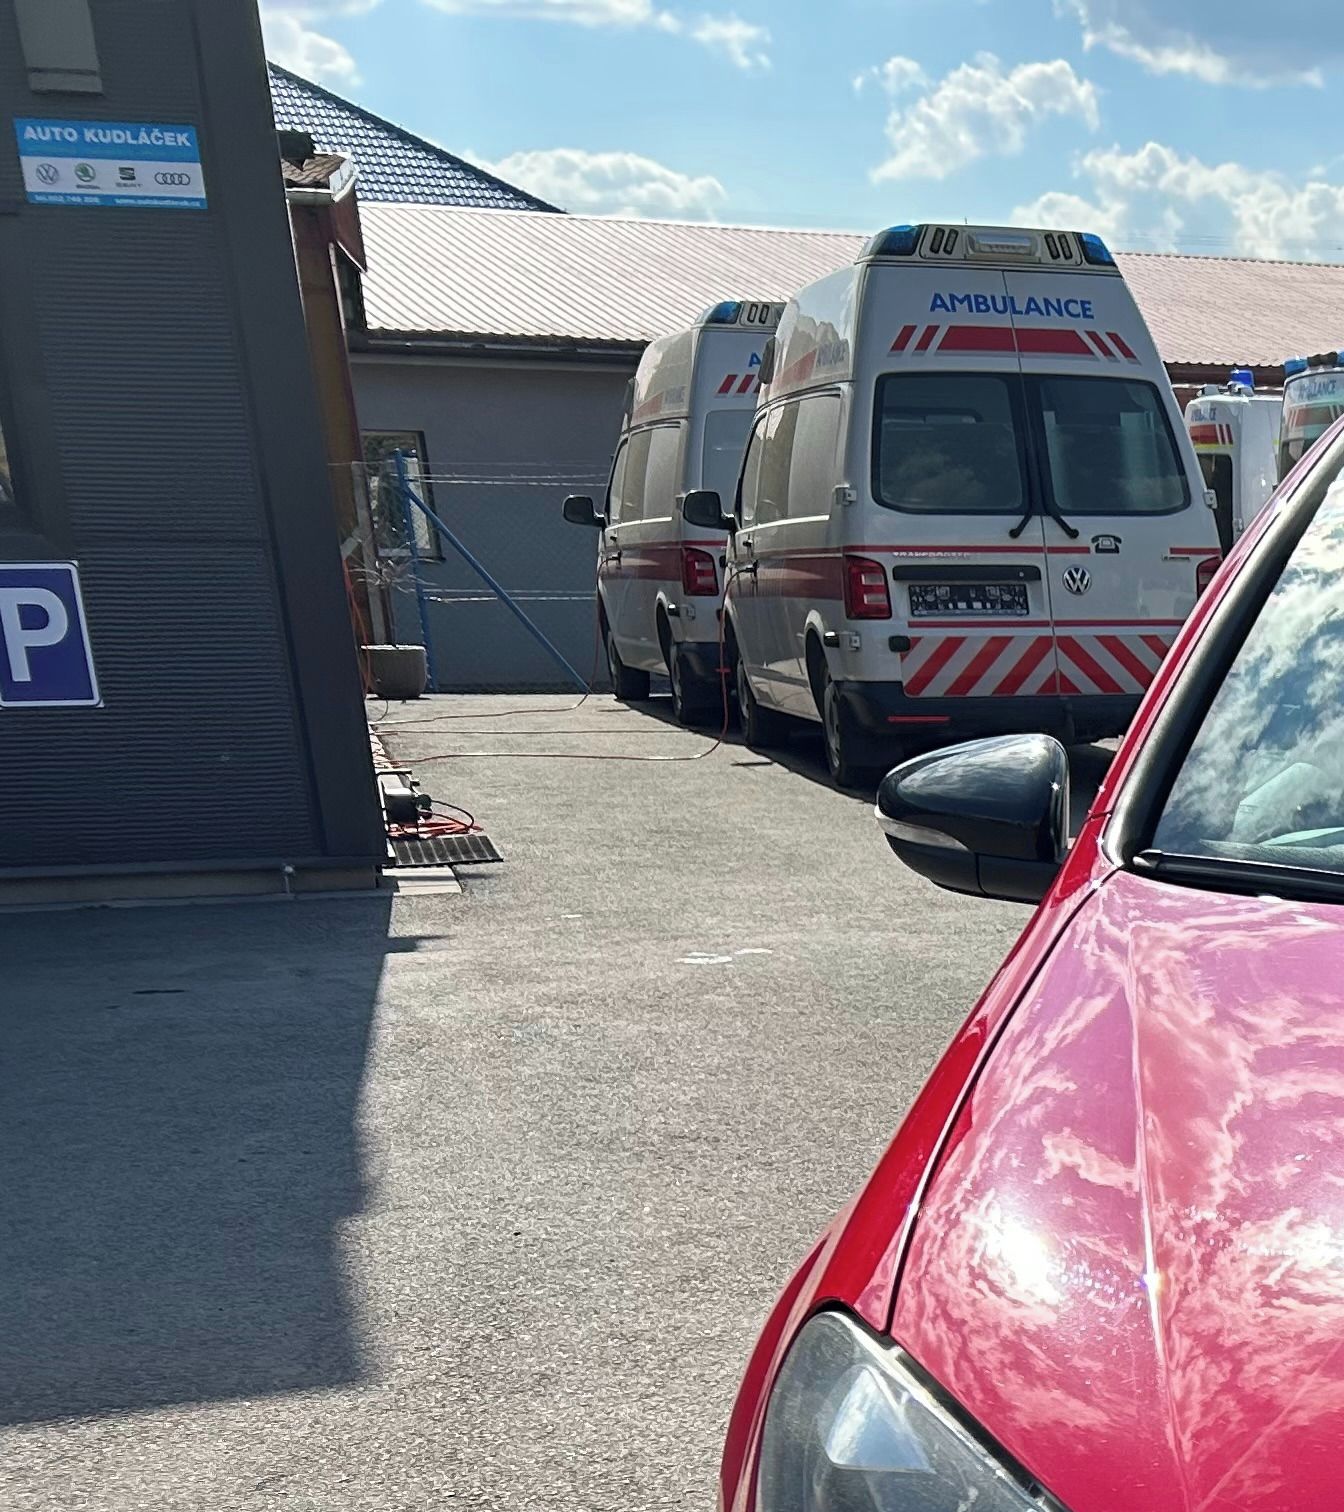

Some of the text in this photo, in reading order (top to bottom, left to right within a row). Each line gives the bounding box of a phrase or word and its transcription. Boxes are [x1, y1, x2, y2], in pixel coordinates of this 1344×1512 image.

[23, 126, 192, 147] AUTO KUDLÁČEK
[929, 292, 1095, 320] AMBULANCE
[0, 587, 68, 682] P
